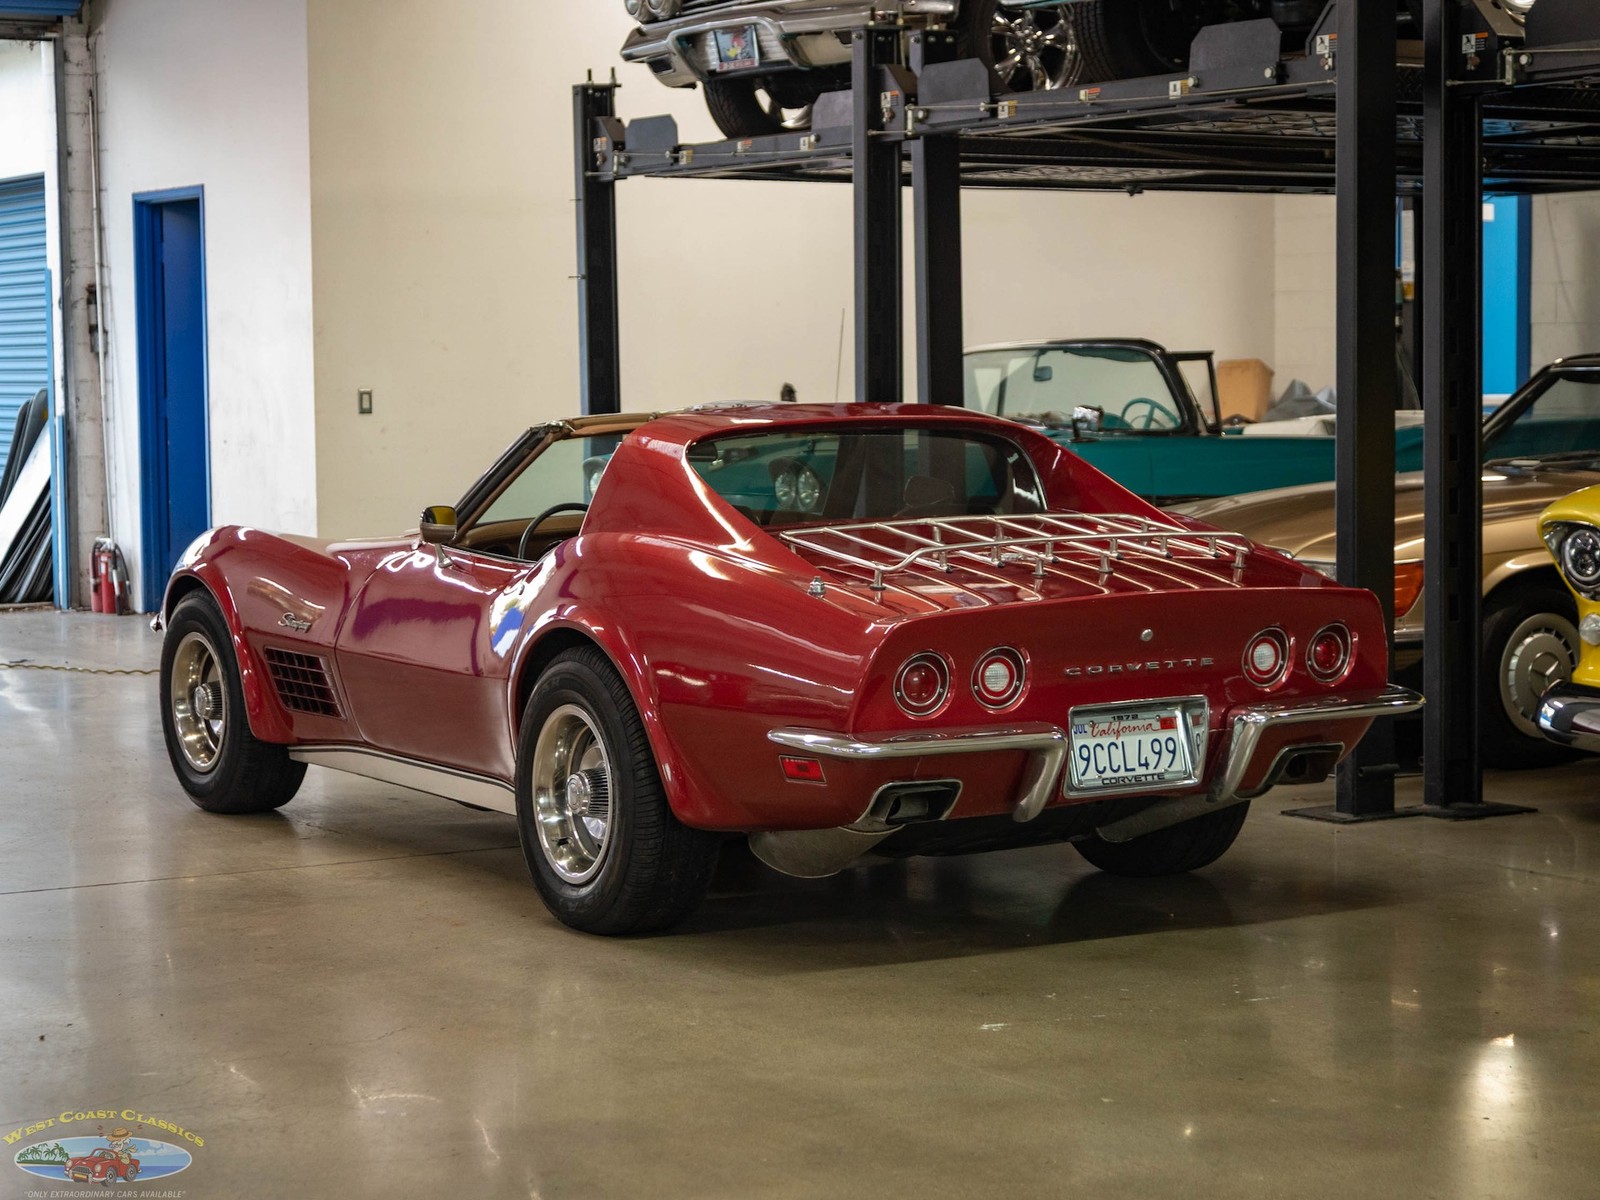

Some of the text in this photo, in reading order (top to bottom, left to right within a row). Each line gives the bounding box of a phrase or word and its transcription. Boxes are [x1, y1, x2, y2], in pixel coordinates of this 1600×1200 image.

[1065, 658, 1214, 675] CORVETTE
[1073, 723, 1088, 735] JUL
[1090, 721, 1159, 740] California
[1078, 736, 1177, 777] 9CCL499
[1101, 772, 1166, 786] CORVETTE
